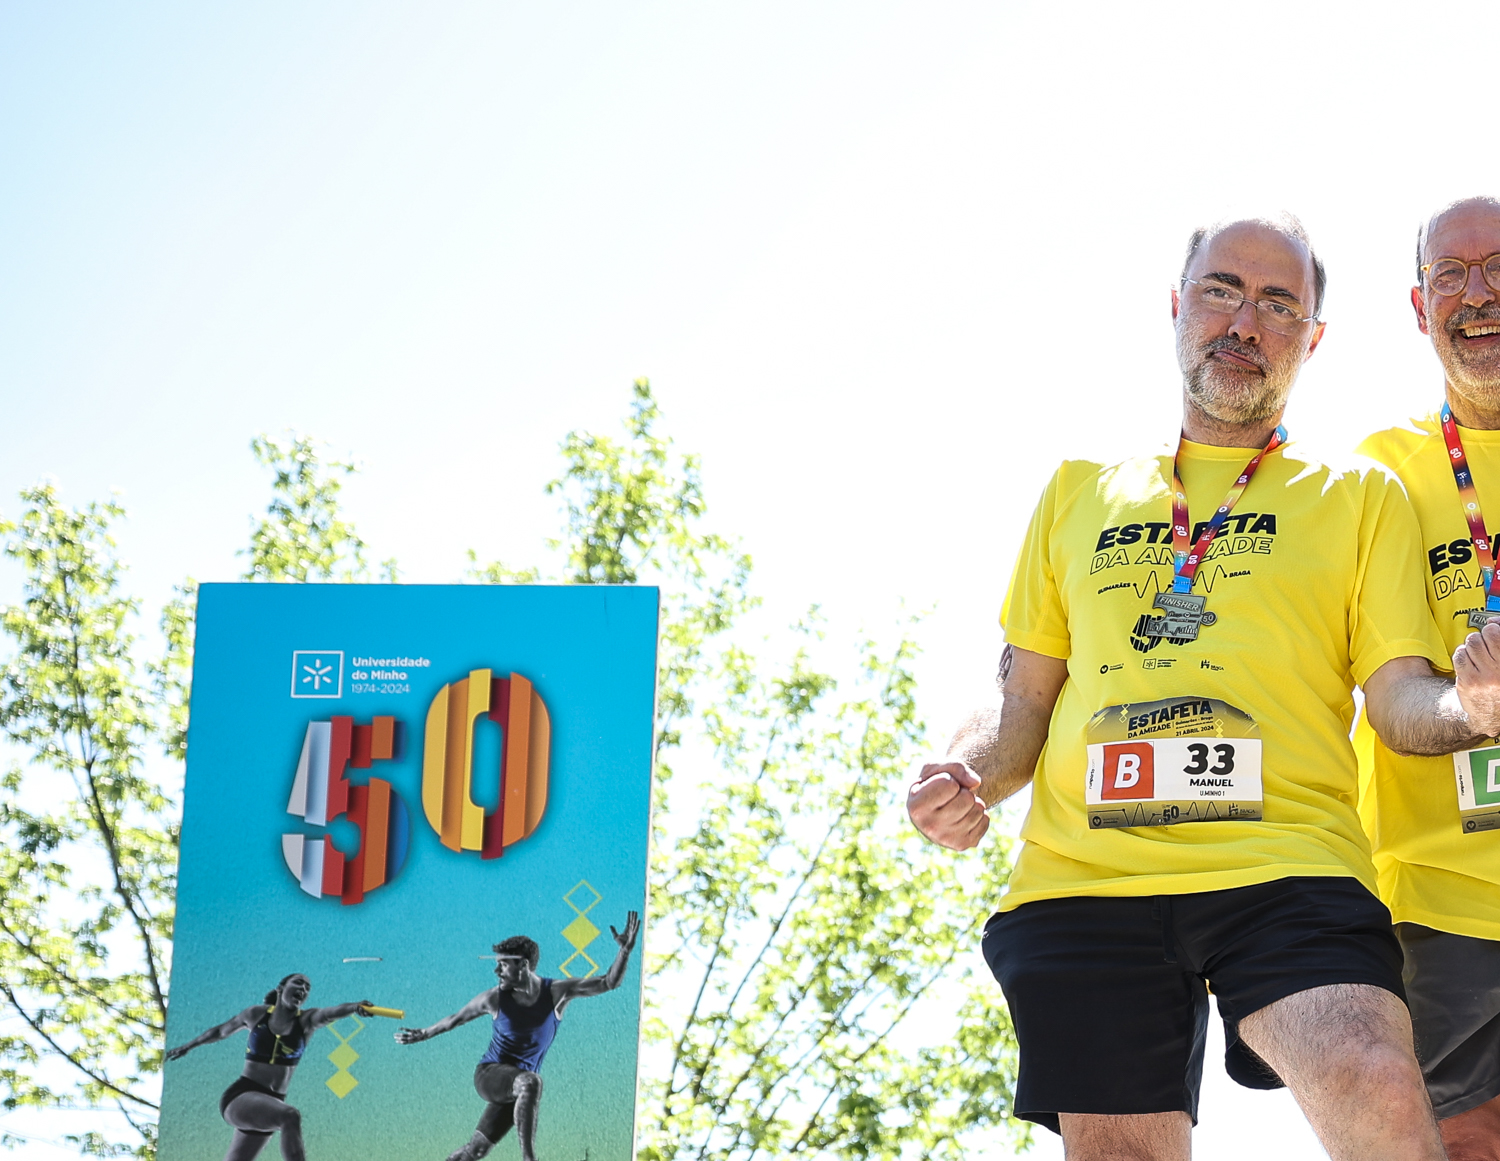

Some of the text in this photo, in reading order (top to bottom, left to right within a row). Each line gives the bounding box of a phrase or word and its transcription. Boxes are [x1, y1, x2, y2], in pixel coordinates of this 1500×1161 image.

[1450, 448, 1462, 458] 50
[1175, 525, 1188, 536] 50
[1476, 539, 1488, 550] 50
[1090, 549, 1129, 575] DA
[1188, 555, 1198, 564] 50
[1228, 570, 1251, 578] BRAGA
[1098, 582, 1130, 594] GUIMARÃES
[1432, 569, 1471, 600] DA
[1160, 596, 1199, 612] FINISHER
[1202, 614, 1214, 622] 50
[352, 656, 431, 667] Universidade
[352, 670, 408, 680] do Minho
[352, 684, 410, 694] 1974-2024
[1128, 700, 1213, 731] ESTAFETA
[1128, 730, 1138, 739] DA
[1138, 723, 1171, 736] AMIZADE
[1183, 743, 1236, 776] 33
[1113, 753, 1141, 789] B
[282, 668, 550, 905] 50
[1190, 778, 1234, 787] MANUEL
[1163, 806, 1180, 822] 50
